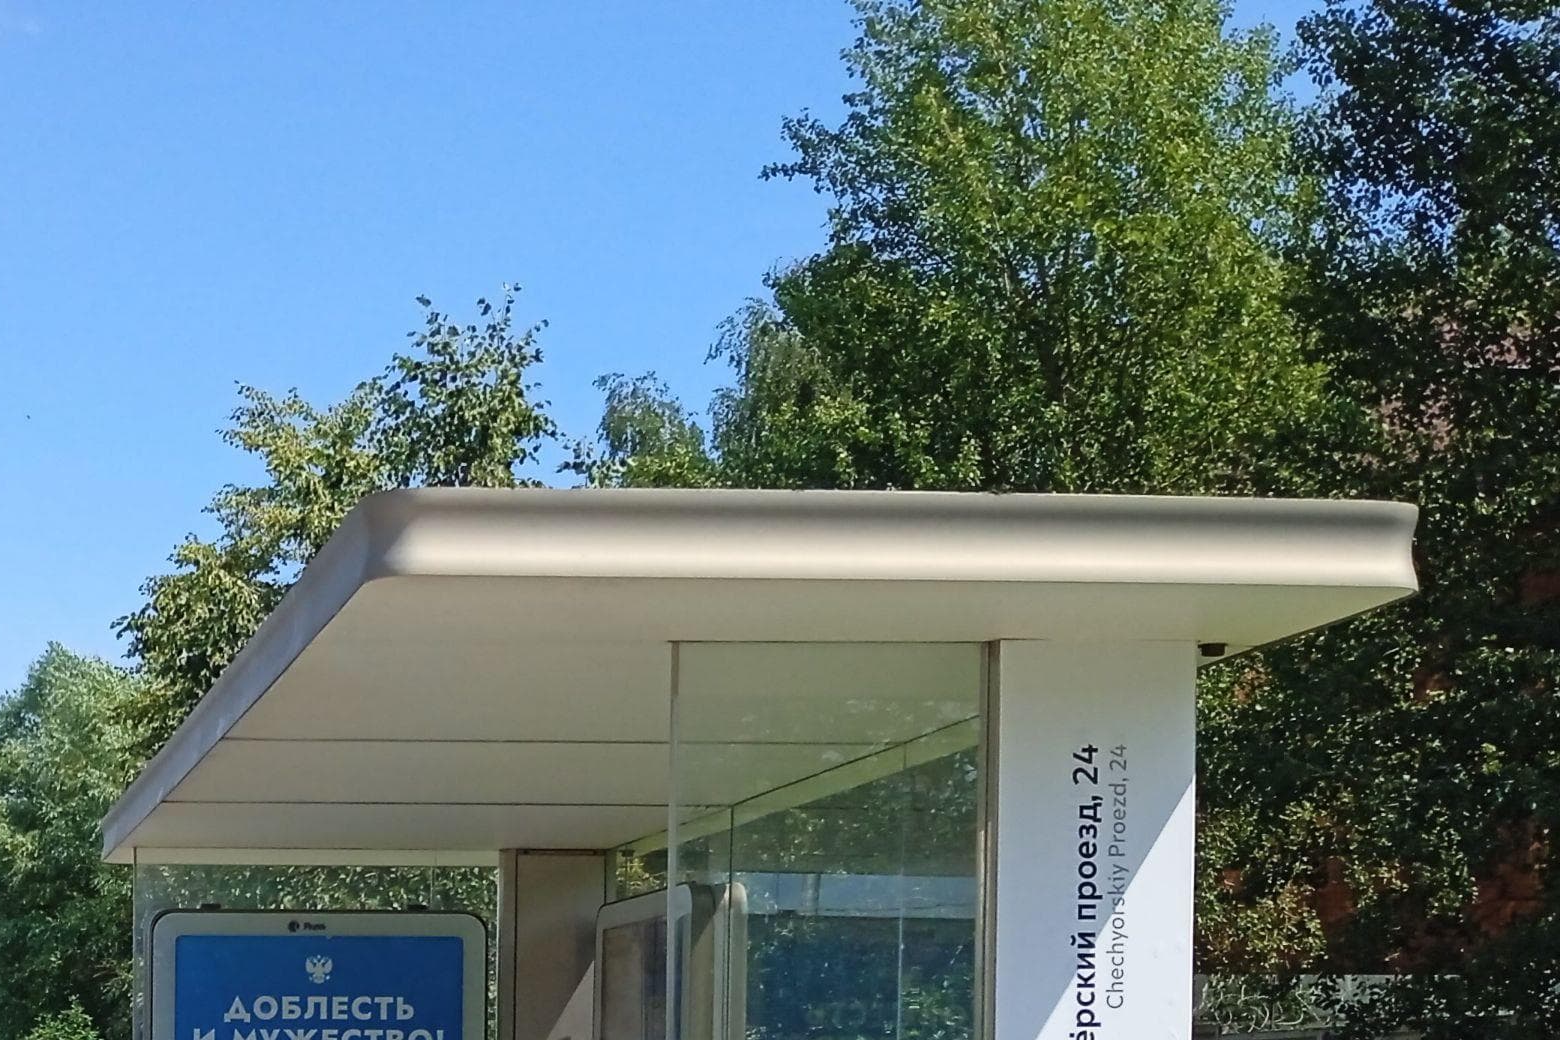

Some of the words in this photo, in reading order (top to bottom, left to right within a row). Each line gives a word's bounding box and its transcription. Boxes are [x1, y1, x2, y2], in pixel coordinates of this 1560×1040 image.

[1073, 743, 1100, 786] 24
[1109, 743, 1128, 771] 24
[1108, 777, 1129, 858] Proezd,
[1077, 795, 1103, 922] проезд,
[1106, 863, 1129, 1010] Chechyorskiy
[223, 995, 415, 1023] ДОБЛЕСТЬ
